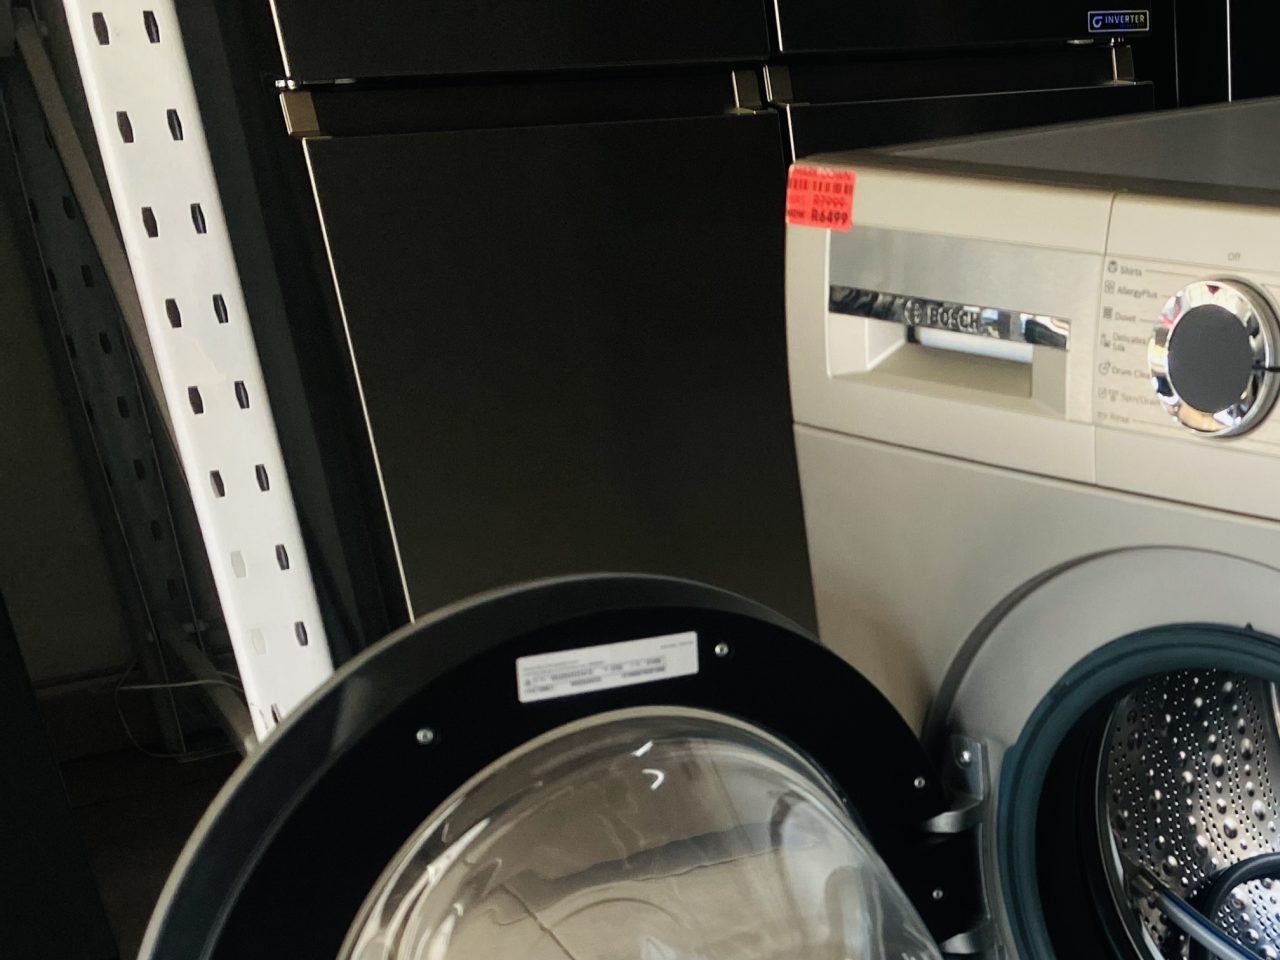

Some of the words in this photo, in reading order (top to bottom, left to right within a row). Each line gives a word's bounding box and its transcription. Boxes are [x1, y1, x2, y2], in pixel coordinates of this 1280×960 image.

[1105, 14, 1145, 24] INVERTER
[811, 207, 849, 225] R6499
[926, 304, 979, 333] BOSCH
